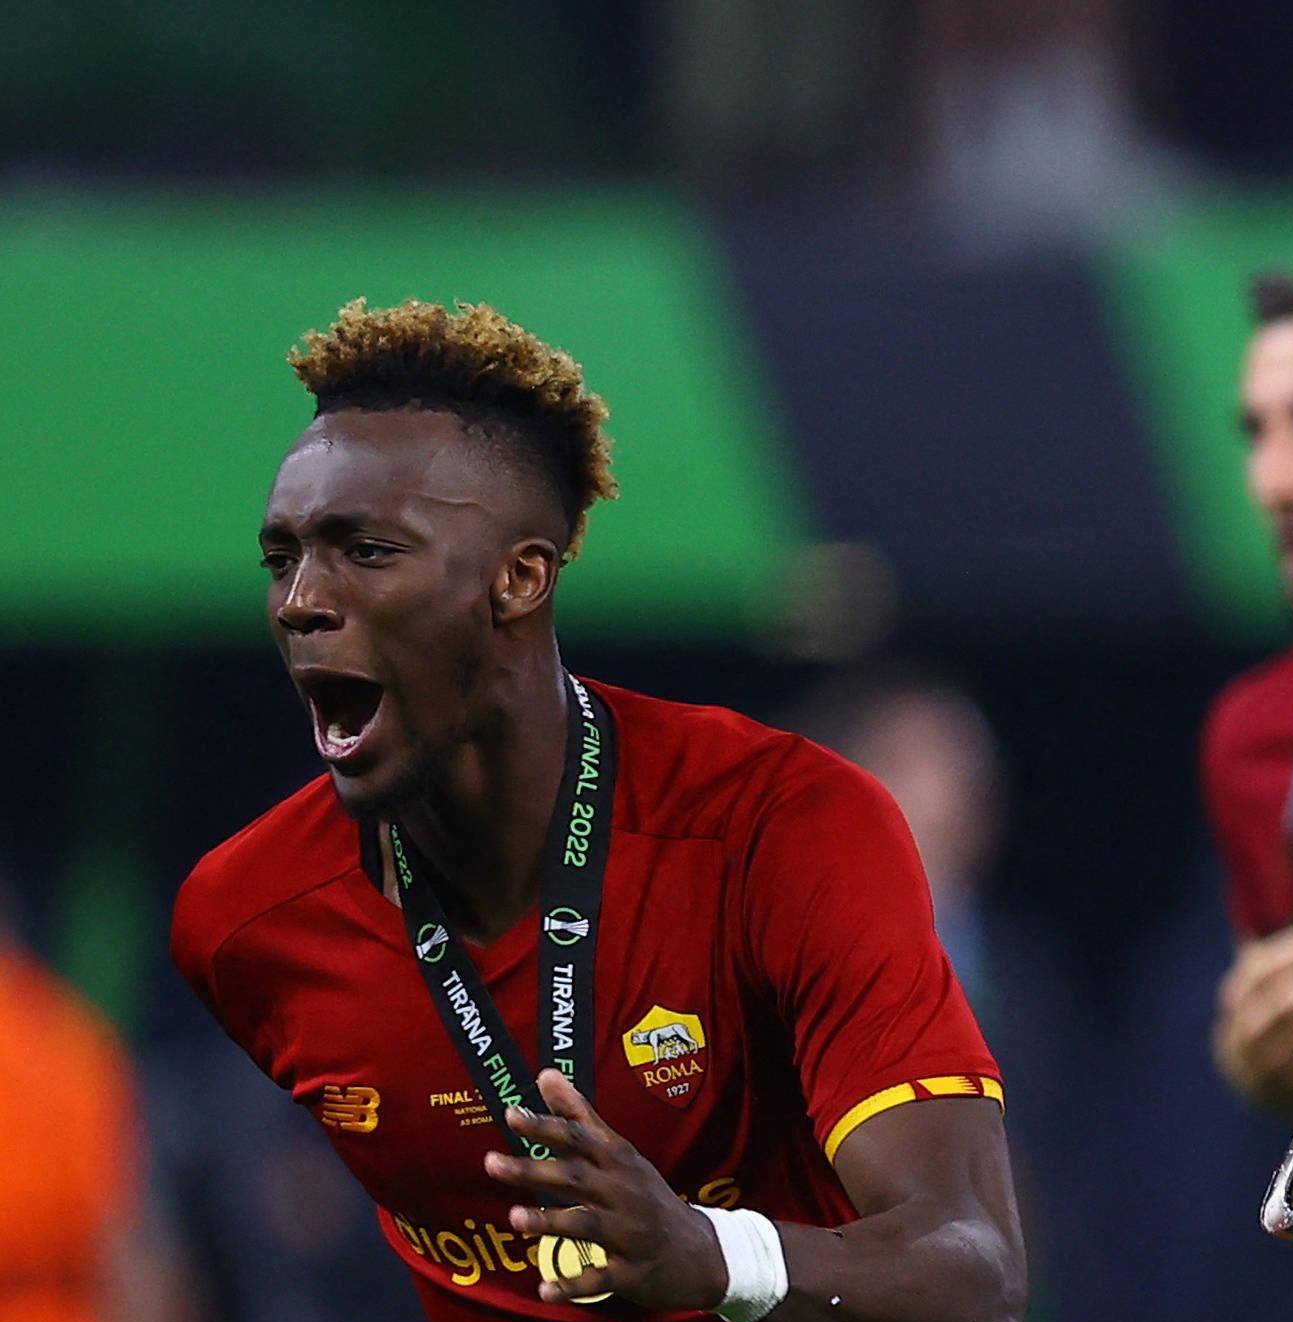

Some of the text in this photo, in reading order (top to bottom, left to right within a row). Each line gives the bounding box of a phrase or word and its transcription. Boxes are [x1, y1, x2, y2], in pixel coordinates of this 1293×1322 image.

[575, 721, 601, 796] FINAL
[563, 802, 595, 868] 2022
[483, 1054, 526, 1112] FINA
[643, 1059, 704, 1087] ROMA
[666, 1082, 690, 1098] 1927
[431, 1091, 472, 1106] FINAL
